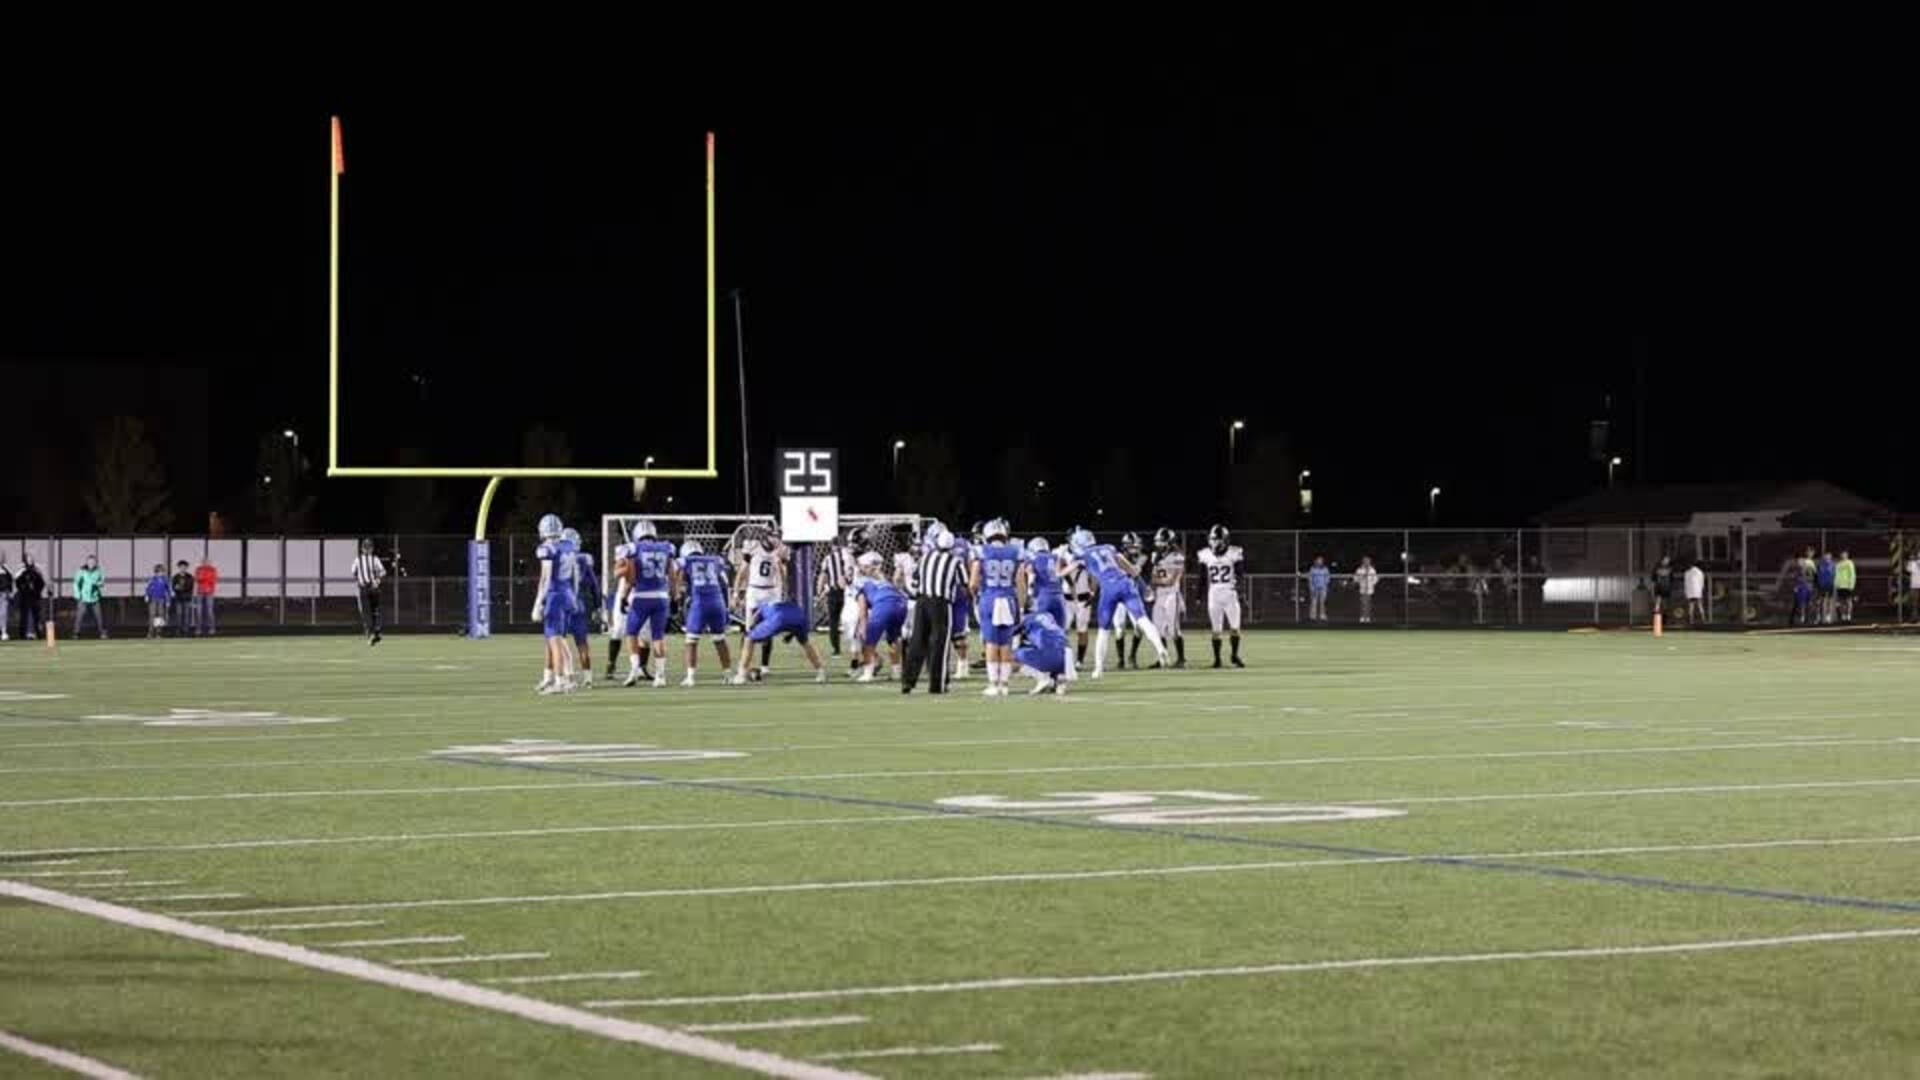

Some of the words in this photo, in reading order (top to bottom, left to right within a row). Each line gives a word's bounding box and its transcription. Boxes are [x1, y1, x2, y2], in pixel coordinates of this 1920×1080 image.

[784, 452, 831, 492] 25
[641, 551, 668, 579] 53
[759, 561, 771, 577] 6
[985, 560, 1014, 586] 99
[1209, 565, 1231, 583] 22
[935, 790, 1407, 823] 50
